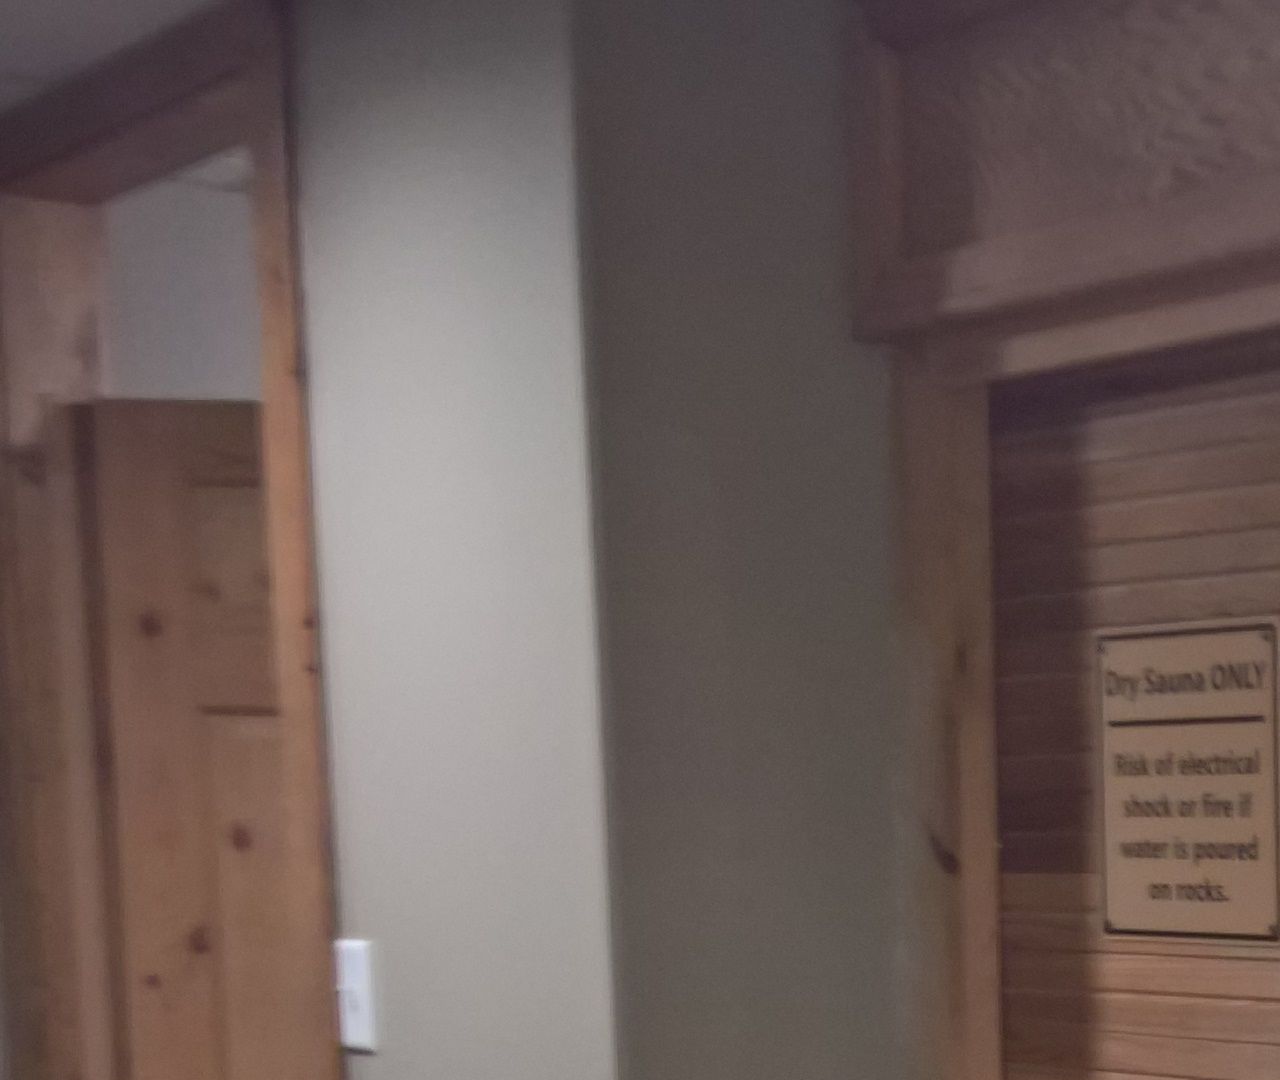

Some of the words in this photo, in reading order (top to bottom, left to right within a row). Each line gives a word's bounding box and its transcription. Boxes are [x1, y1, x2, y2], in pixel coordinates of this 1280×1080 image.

[1105, 669, 1138, 701] Dry
[1144, 666, 1205, 694] Sauna
[1211, 661, 1265, 690] ONLY
[1114, 752, 1149, 776] Risk
[1154, 751, 1174, 776] of
[1178, 749, 1261, 775] electrical
[1124, 793, 1172, 818] shock
[1178, 799, 1197, 818] or
[1202, 792, 1234, 818] fire
[1239, 792, 1252, 818] if
[1120, 839, 1169, 859] water
[1173, 836, 1190, 860] is
[1193, 834, 1258, 868] poured
[1148, 882, 1173, 901] on
